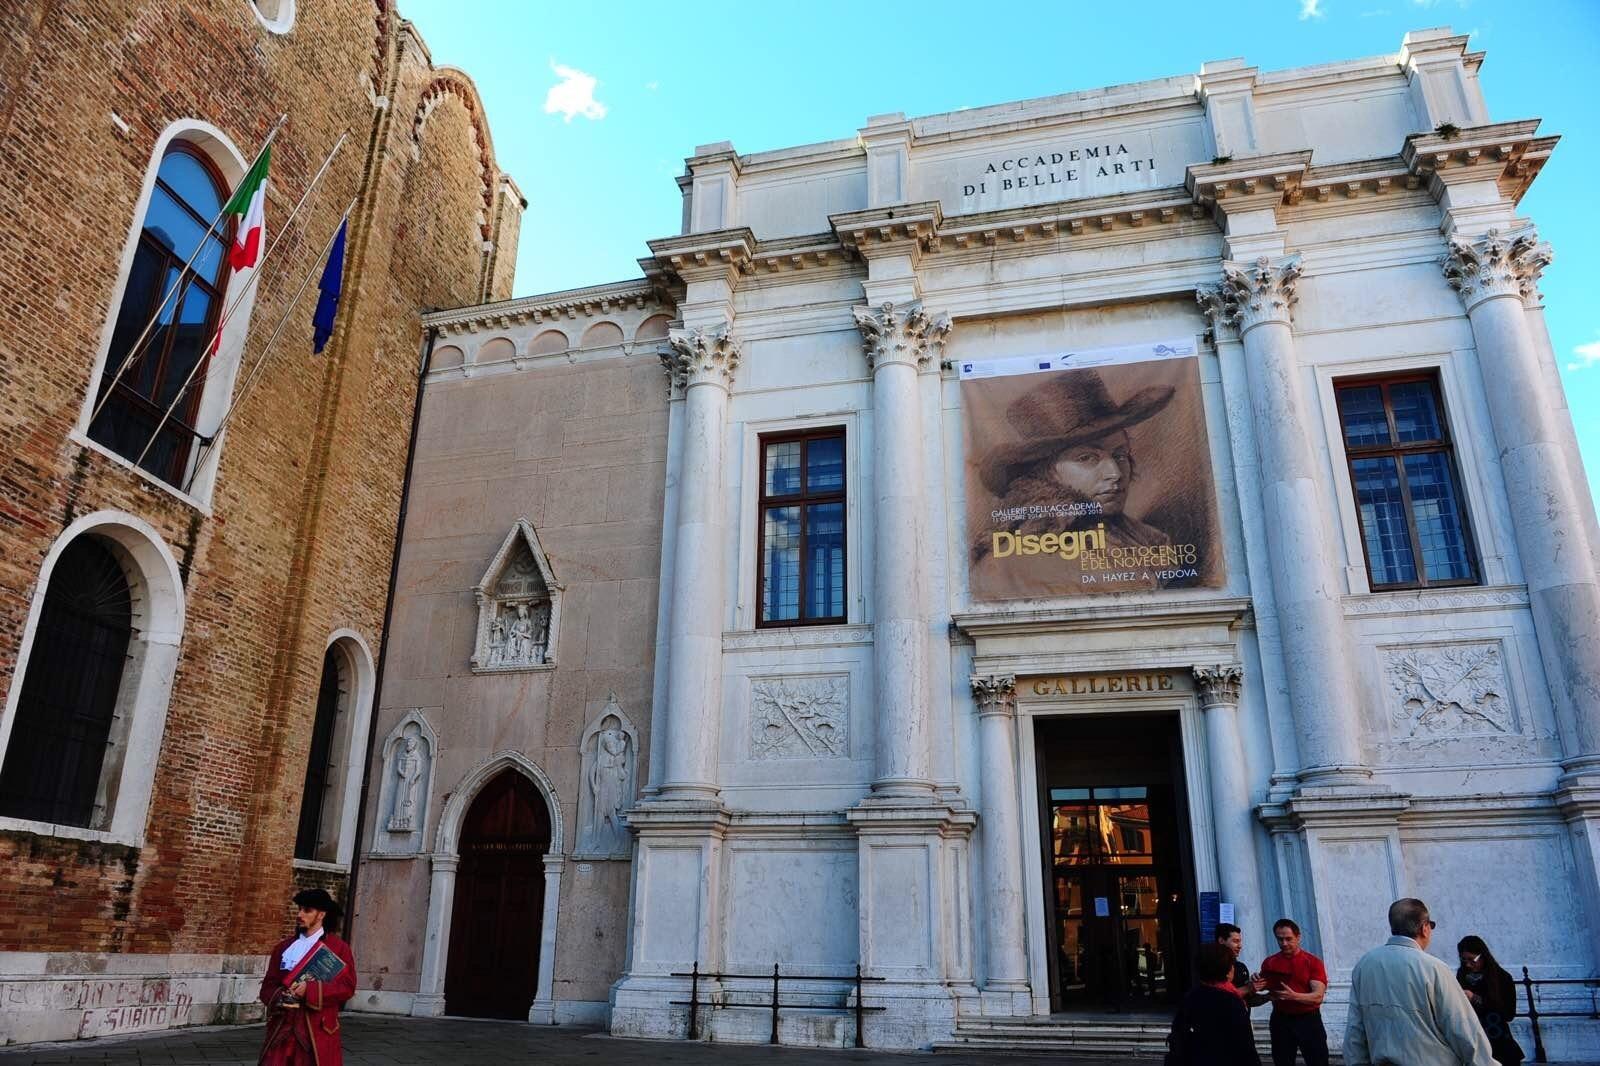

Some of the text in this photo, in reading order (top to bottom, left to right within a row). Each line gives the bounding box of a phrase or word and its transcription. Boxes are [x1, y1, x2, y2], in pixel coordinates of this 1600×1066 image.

[985, 143, 1129, 174] ACCADEMIA
[964, 158, 1155, 197] DI BELLE ARTI
[991, 501, 1102, 518] GALLERIE DELL'ACCADEMIA
[1000, 514, 1026, 522] OTTOBRE
[992, 522, 1106, 560] Disegni
[1081, 553, 1197, 571] E DEL NOVECENTO
[1082, 568, 1198, 584] DA HAYEZ A VEDOVA
[1033, 673, 1173, 696] GALLERIE
